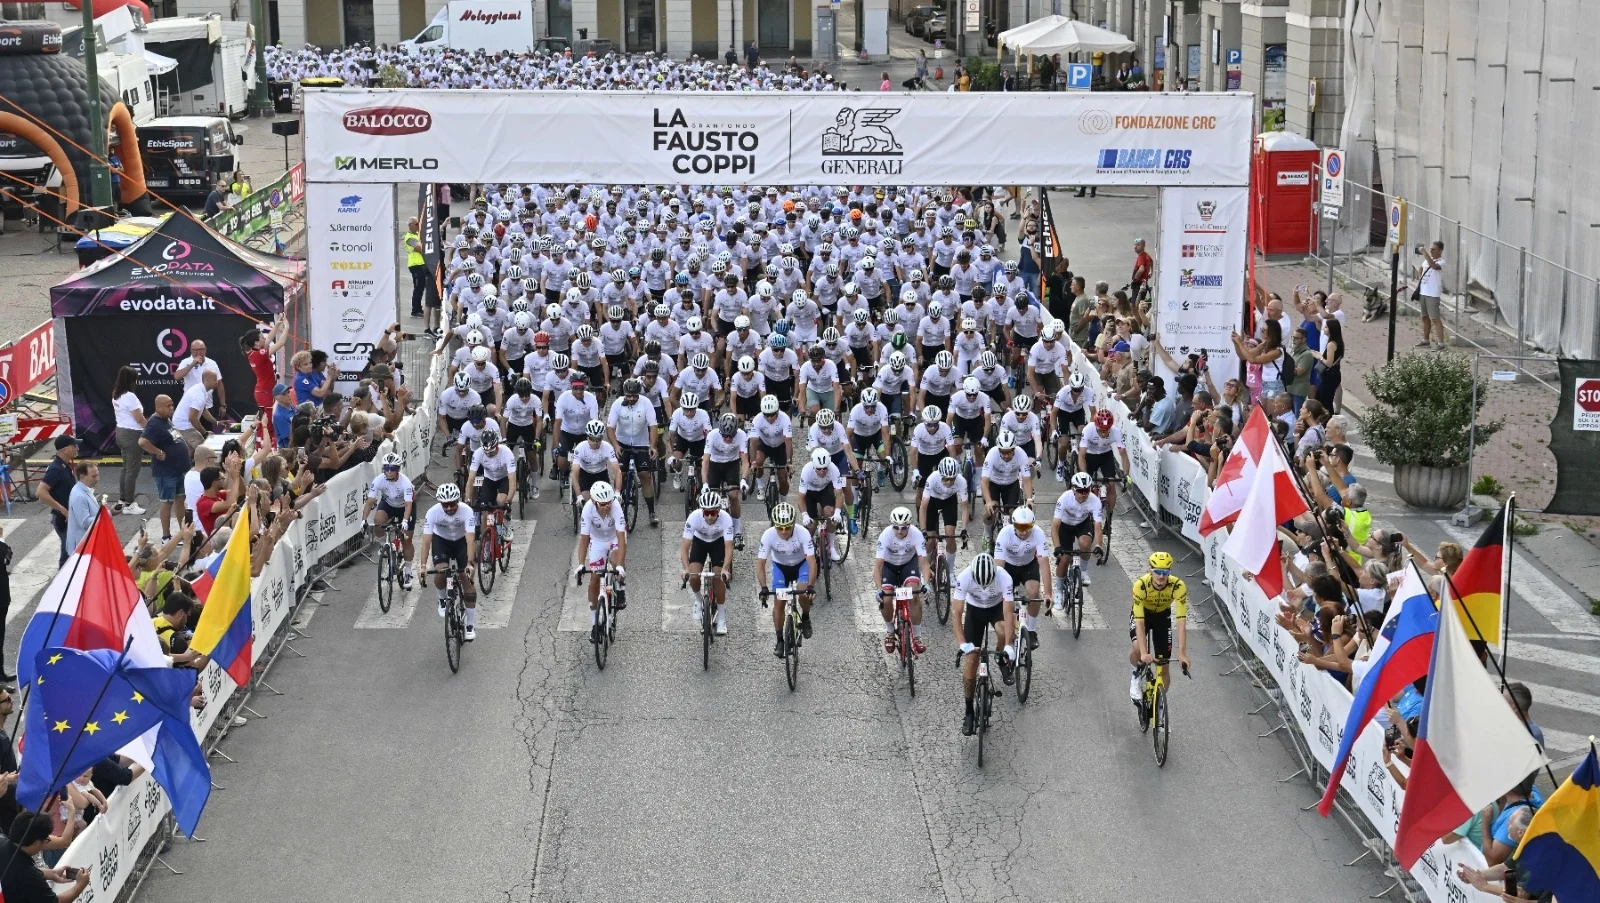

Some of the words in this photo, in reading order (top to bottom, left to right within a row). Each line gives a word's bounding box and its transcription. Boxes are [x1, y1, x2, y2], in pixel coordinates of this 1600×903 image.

[459, 8, 522, 25] Noleggiami
[1231, 50, 1240, 63] P
[1072, 66, 1087, 85] P
[345, 114, 429, 128] BALOCCO
[653, 107, 688, 128] LA
[1115, 115, 1190, 130] FONDAZIONE
[1192, 115, 1217, 130] CRC
[147, 139, 194, 149] EthicSport
[653, 130, 759, 151] FAUSTO
[360, 157, 439, 170] MERLO
[672, 153, 756, 174] COPPI
[1117, 148, 1162, 169] BANCA
[1164, 149, 1193, 169] CRS
[820, 159, 904, 175] GENERALI
[341, 242, 373, 252] tonoli
[120, 294, 216, 311] evodata.it
